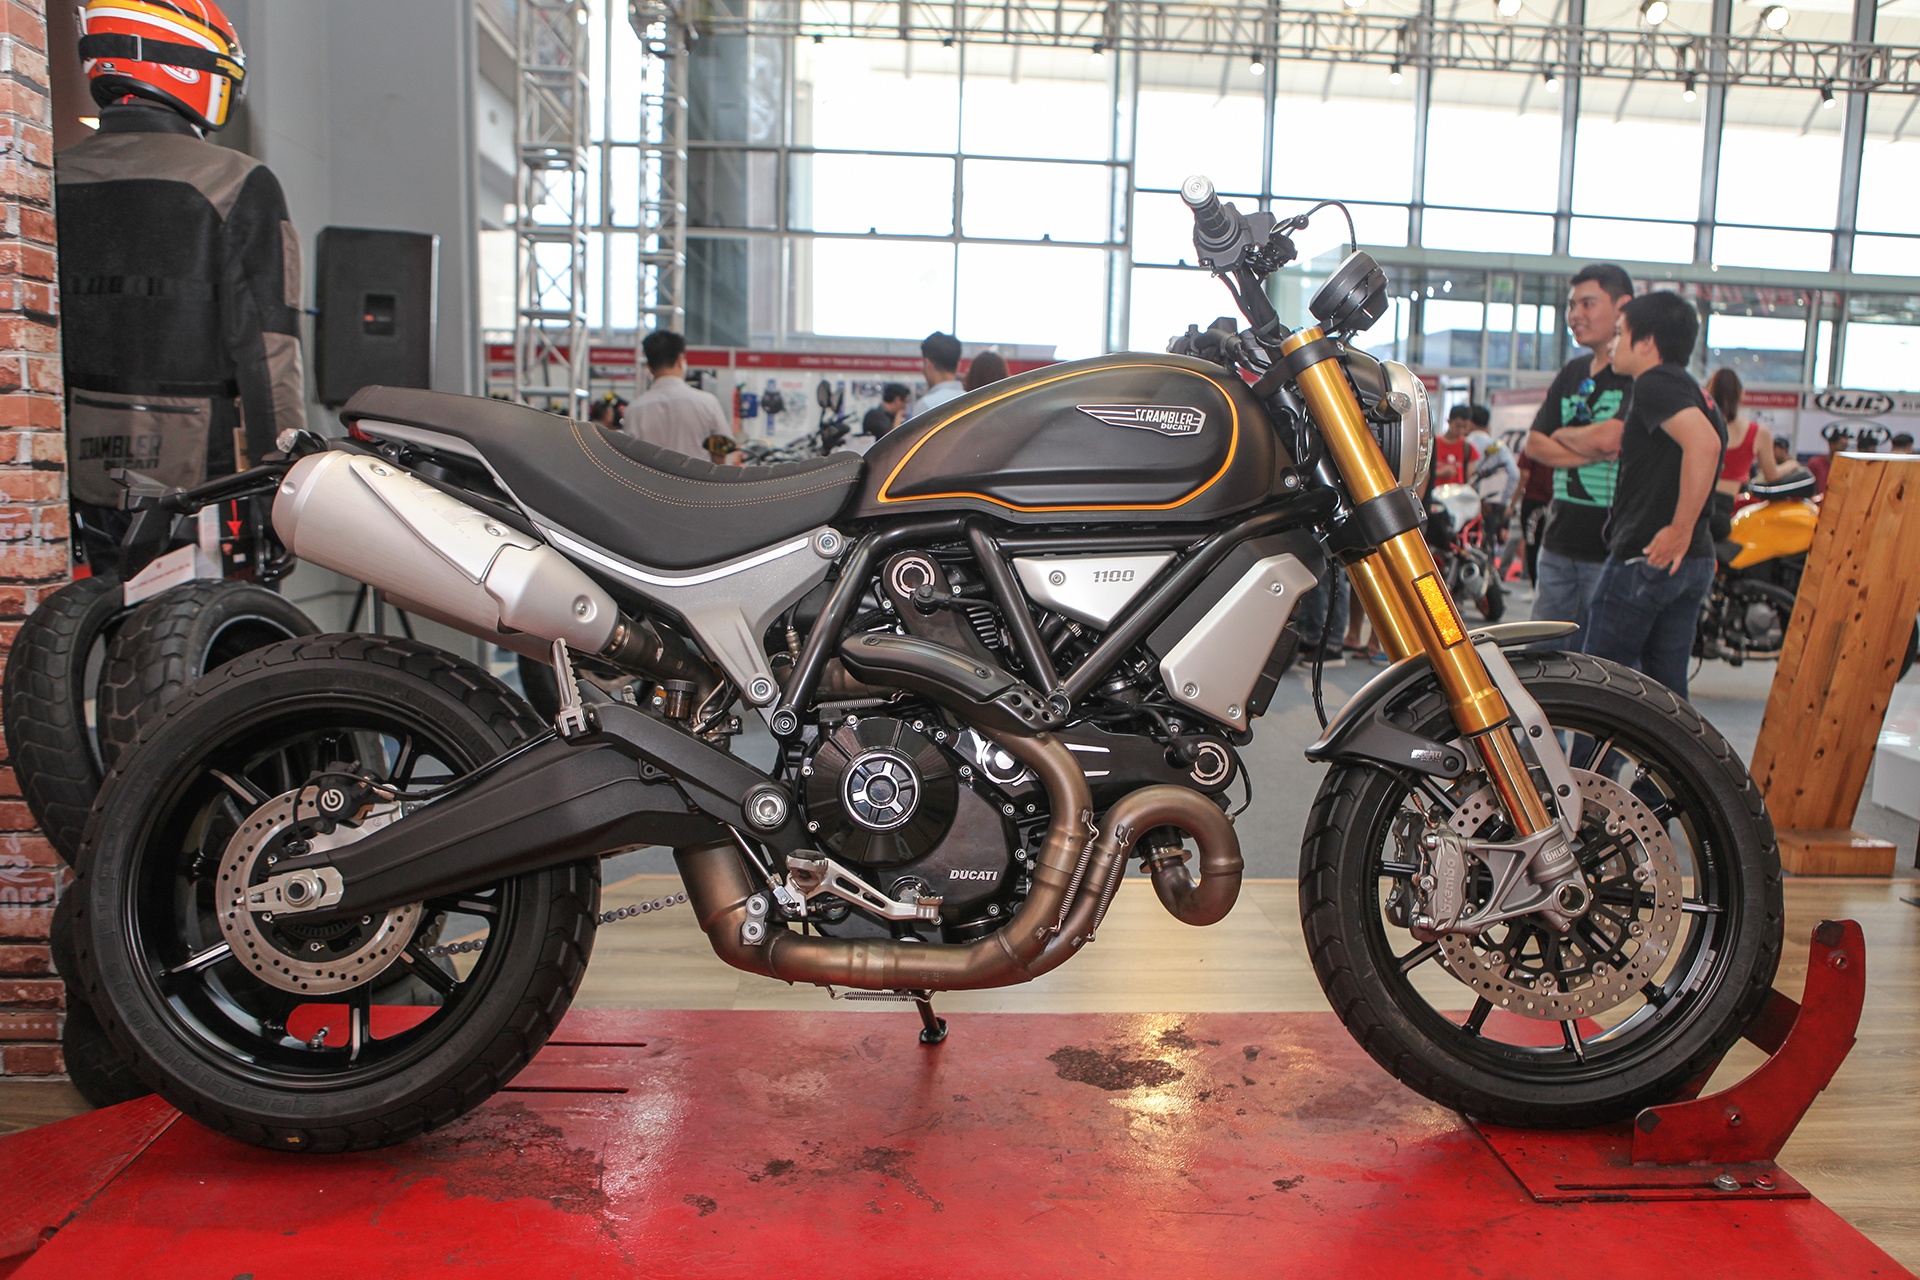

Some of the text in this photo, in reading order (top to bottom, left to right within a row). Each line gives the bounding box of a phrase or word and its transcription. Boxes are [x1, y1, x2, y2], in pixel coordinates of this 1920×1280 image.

[1135, 408, 1194, 425] SCRAMBLER
[1160, 423, 1191, 431] DUCATI
[1093, 569, 1135, 583] 1100
[949, 869, 998, 881] DUCATI
[1441, 858, 1457, 913] brembo
